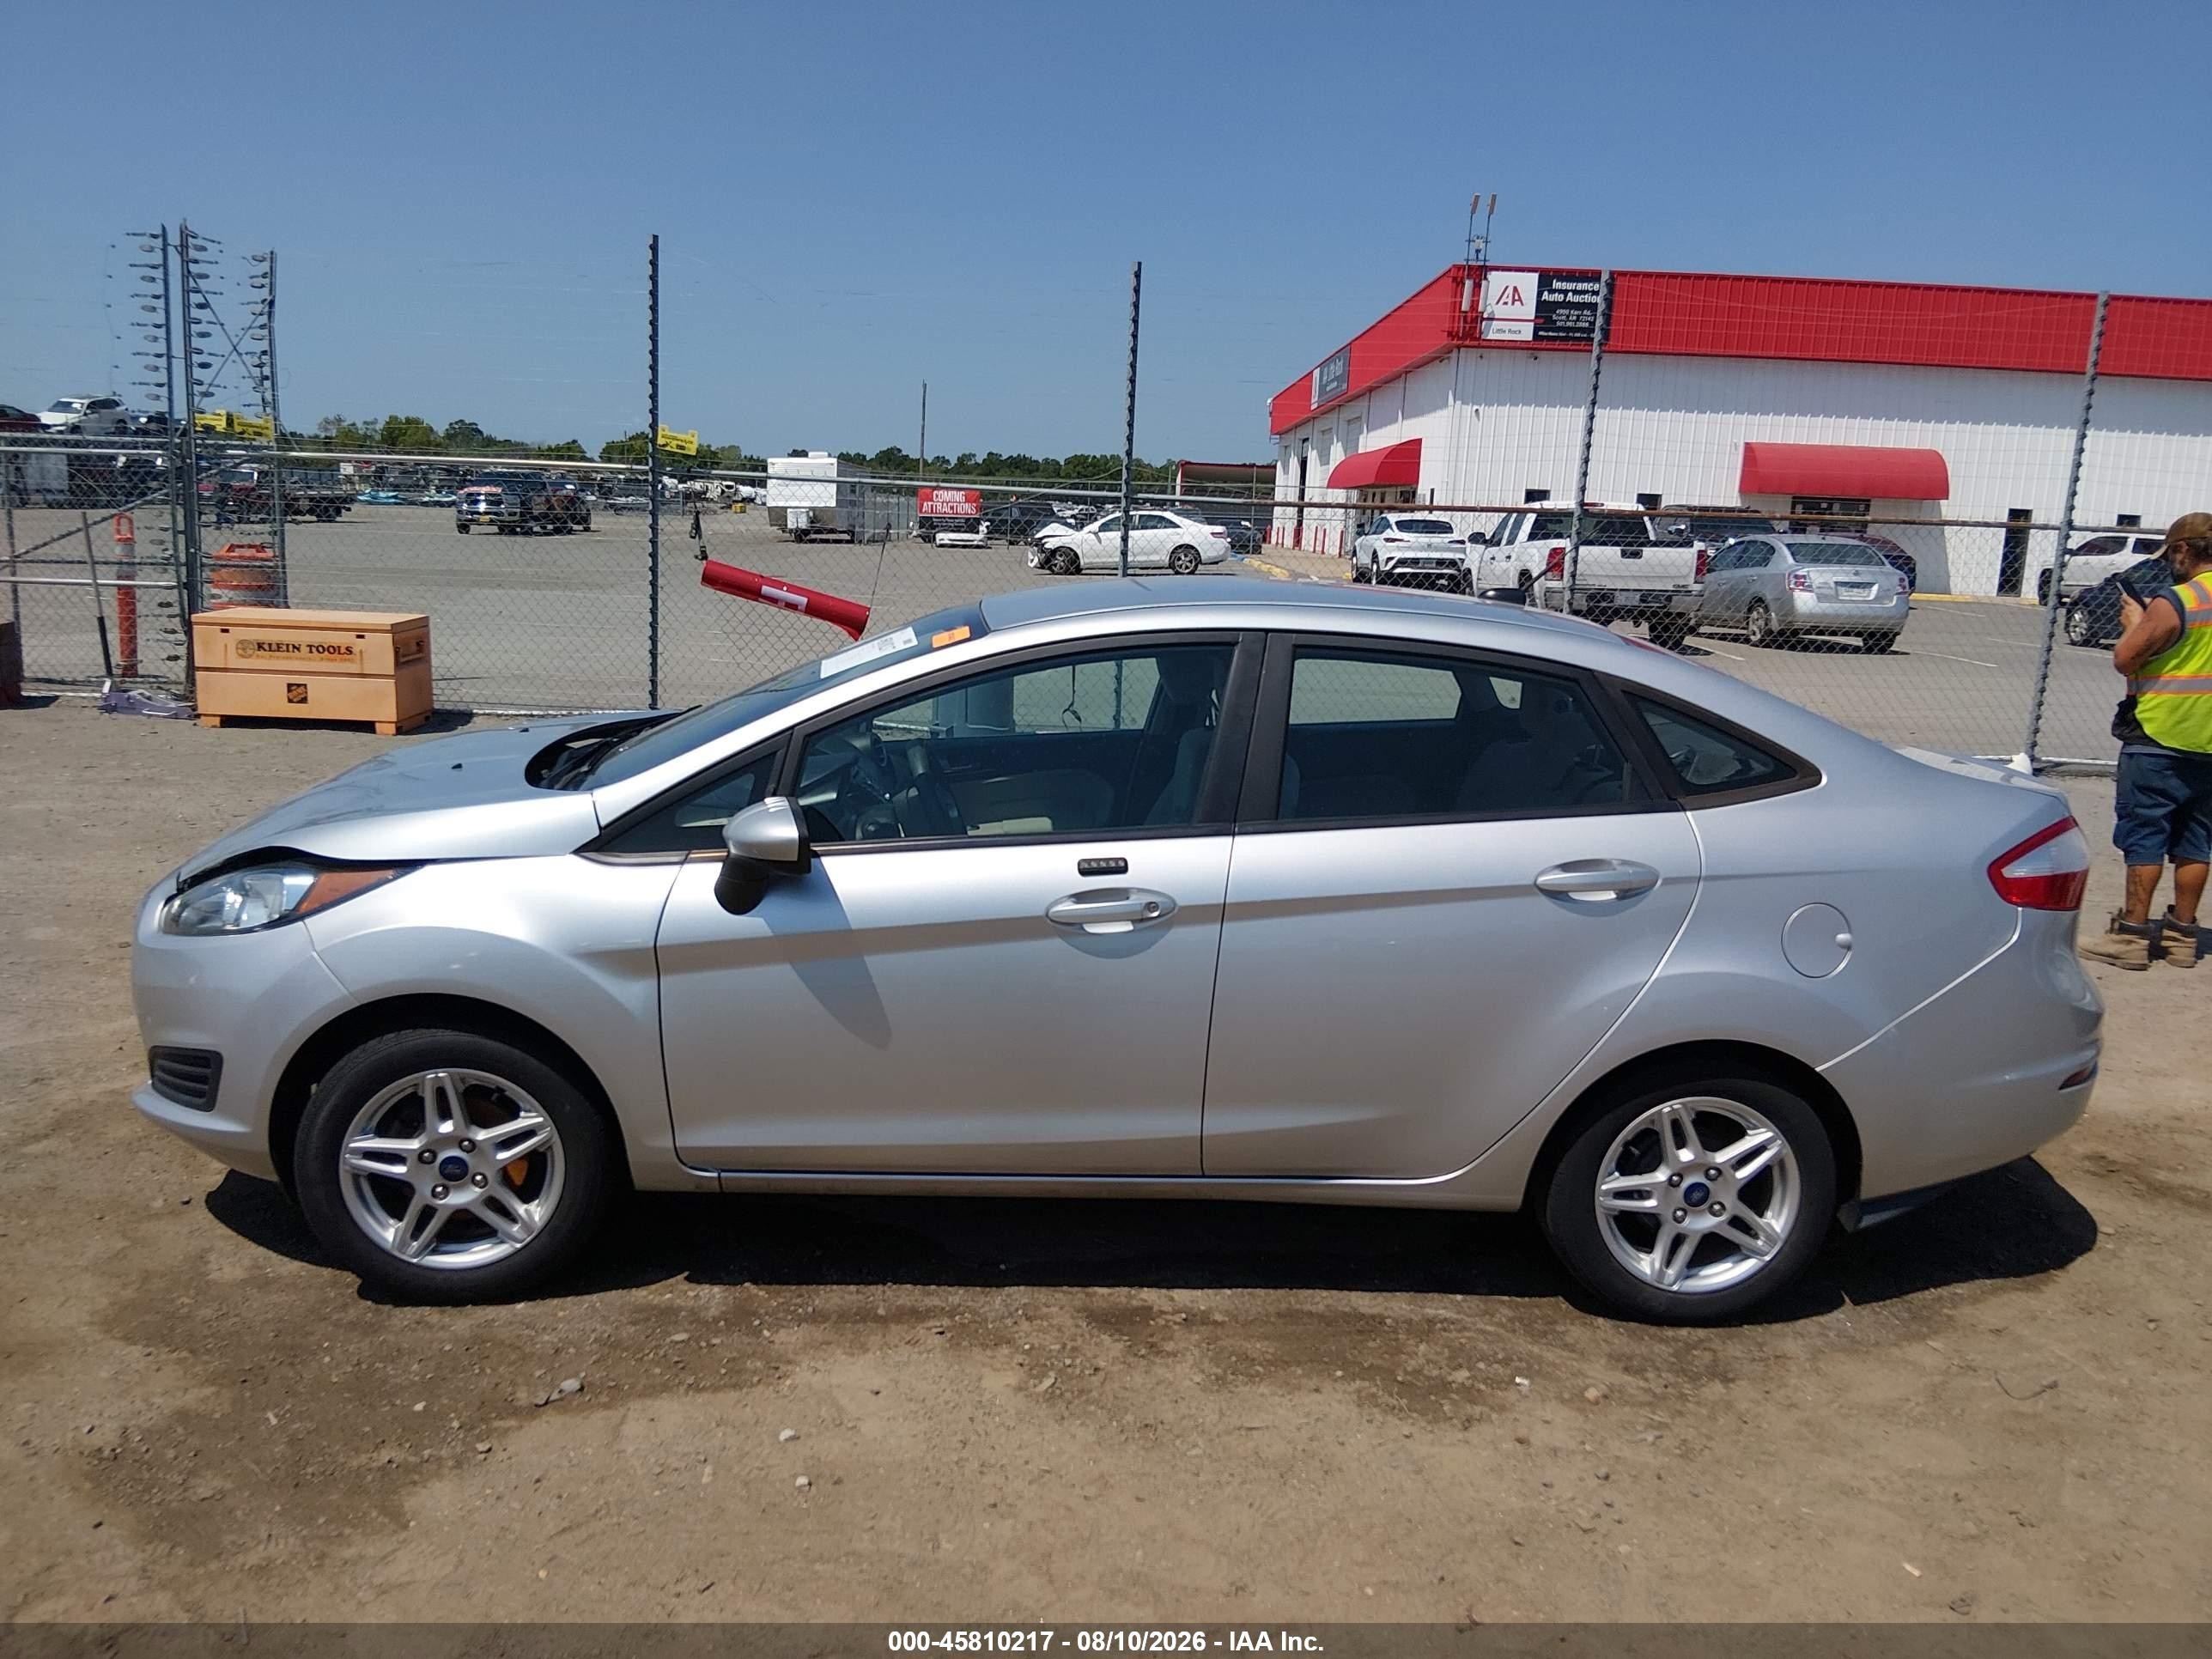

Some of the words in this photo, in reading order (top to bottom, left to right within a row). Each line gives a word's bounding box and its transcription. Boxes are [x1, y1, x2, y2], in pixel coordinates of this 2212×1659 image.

[1553, 279, 1600, 291] Insurance
[1541, 291, 1564, 302] Auto
[933, 490, 965, 502] COMING
[922, 501, 976, 514] ATTRACTIONS
[256, 641, 301, 653] KLEIN
[306, 644, 354, 655] TOOLS
